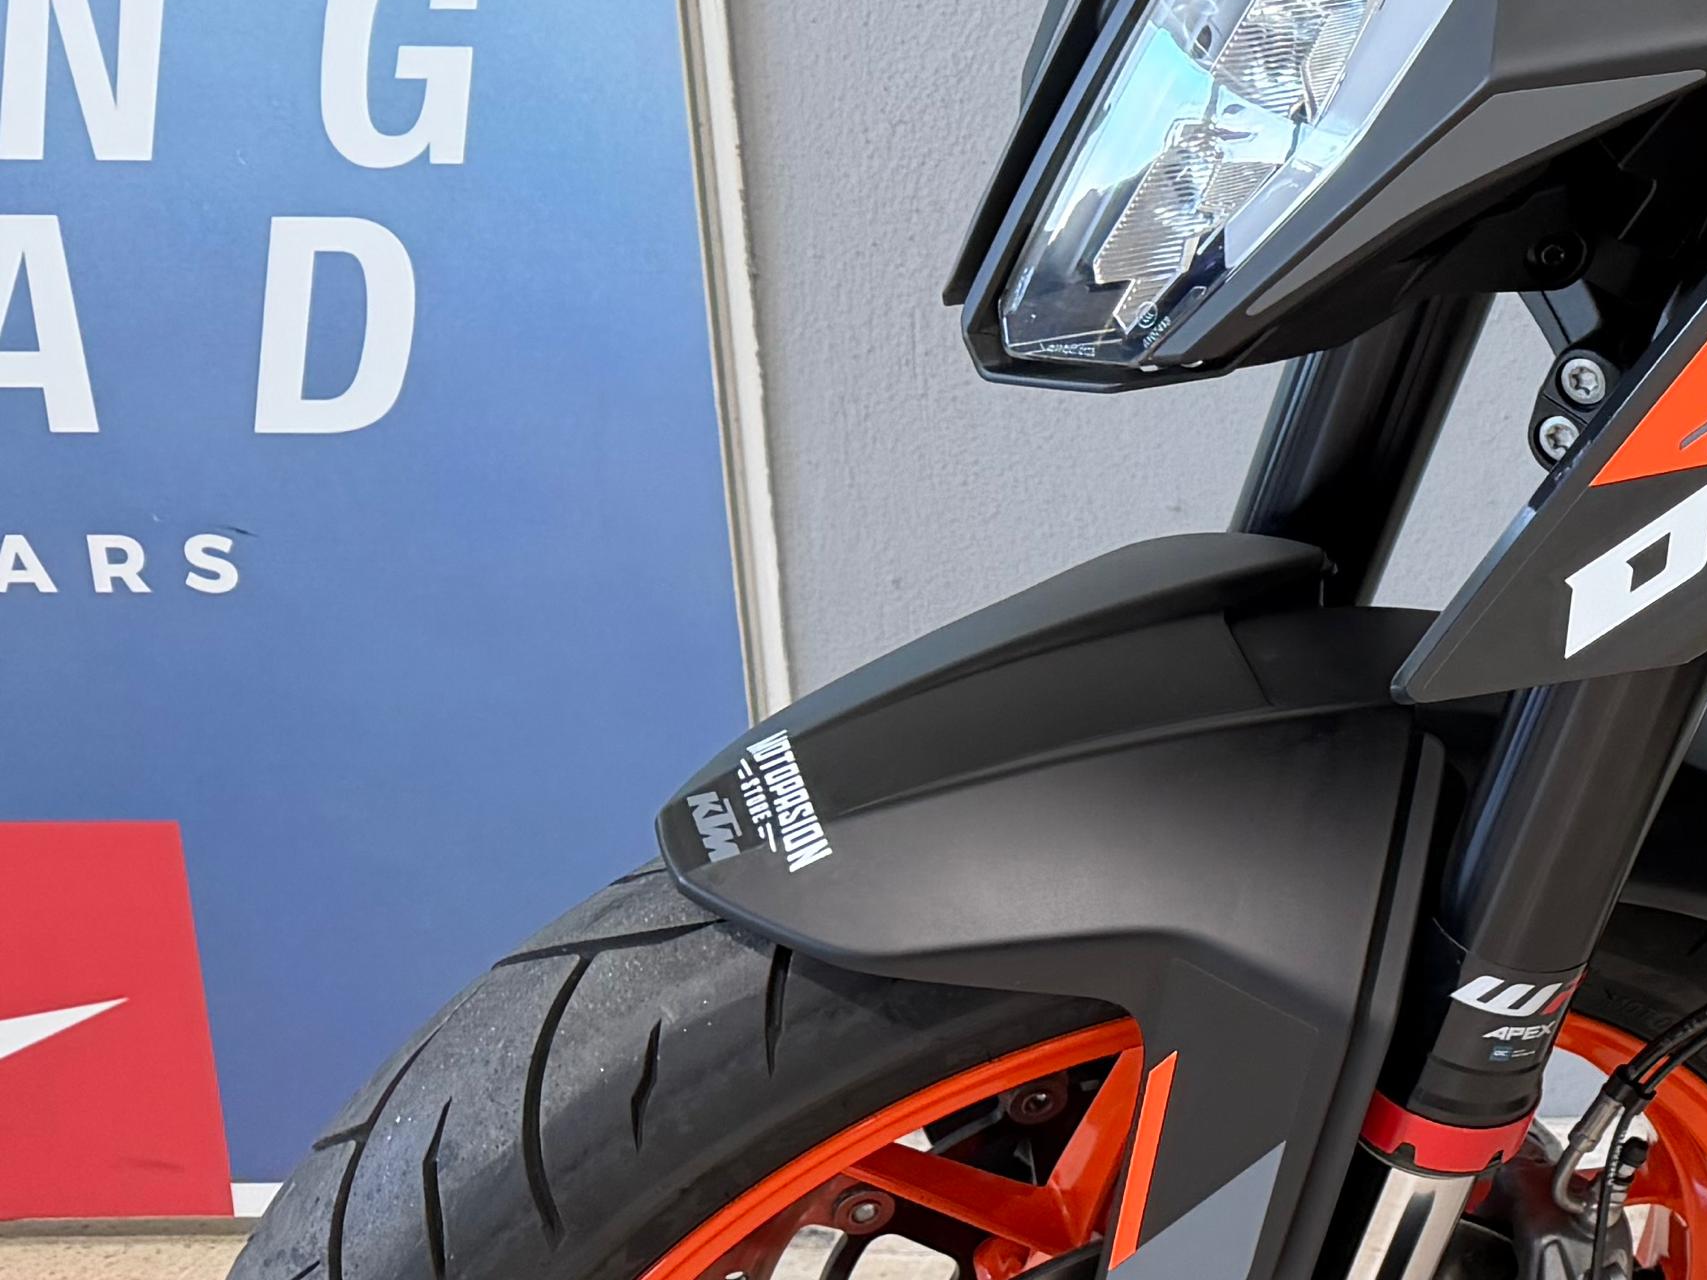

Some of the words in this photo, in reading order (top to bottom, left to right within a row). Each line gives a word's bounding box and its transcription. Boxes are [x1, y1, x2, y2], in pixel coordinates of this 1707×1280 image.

[0, 214, 416, 434] AD
[0, 534, 240, 594] ARS
[687, 791, 743, 863] KTM
[740, 777, 773, 824] STORE
[746, 729, 833, 873] MOTOPASION
[1482, 1020, 1557, 1041] APEX
